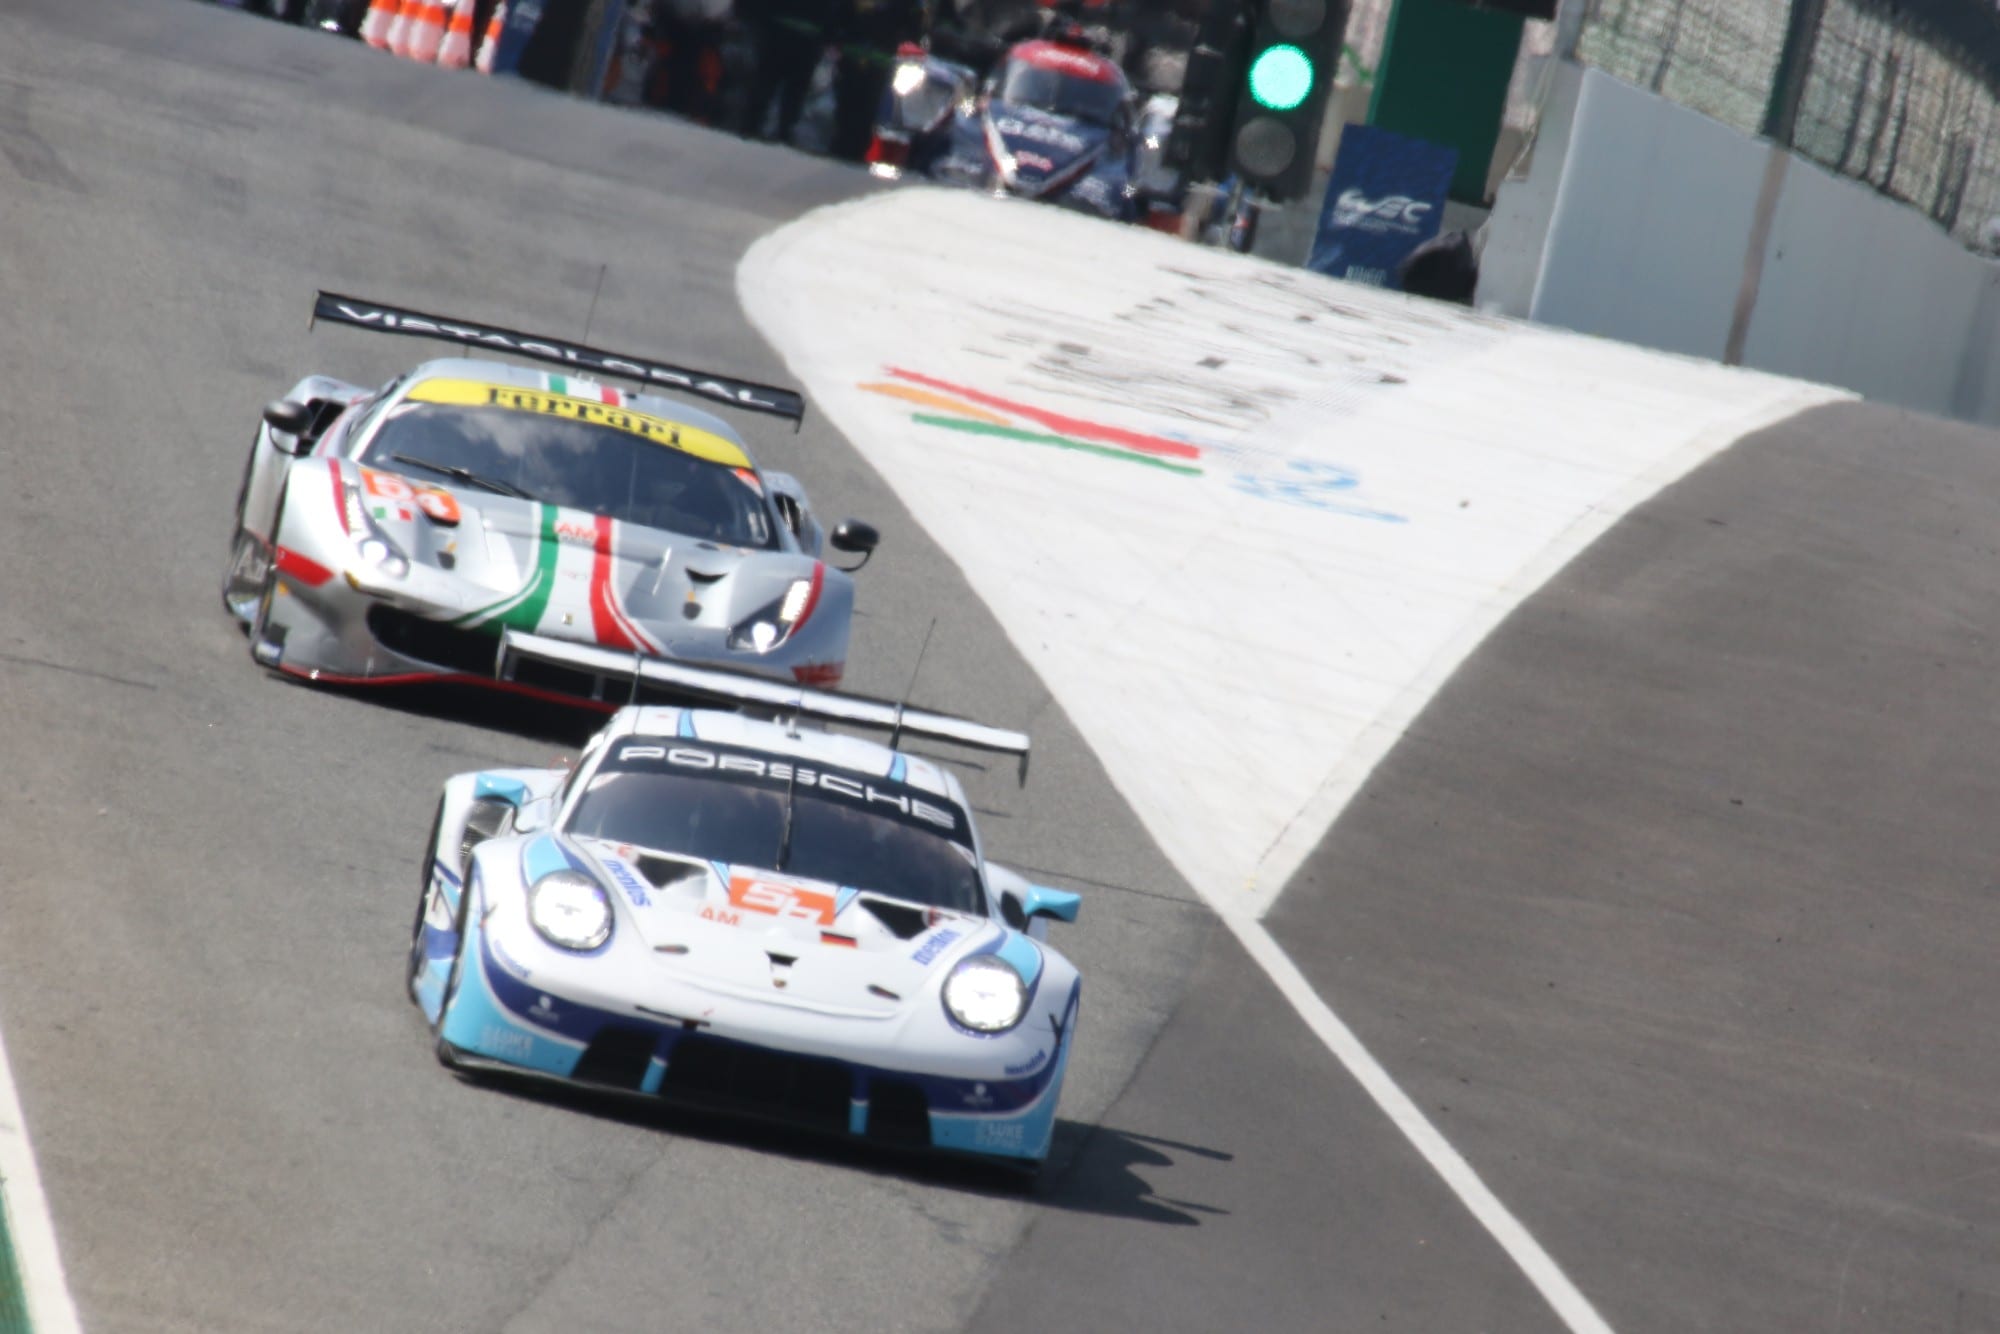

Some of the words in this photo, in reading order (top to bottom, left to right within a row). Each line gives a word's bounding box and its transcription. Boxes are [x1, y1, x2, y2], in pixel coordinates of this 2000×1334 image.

[487, 386, 683, 449] Ferrari
[618, 746, 955, 830] PORSCHE
[700, 904, 741, 927] AM
